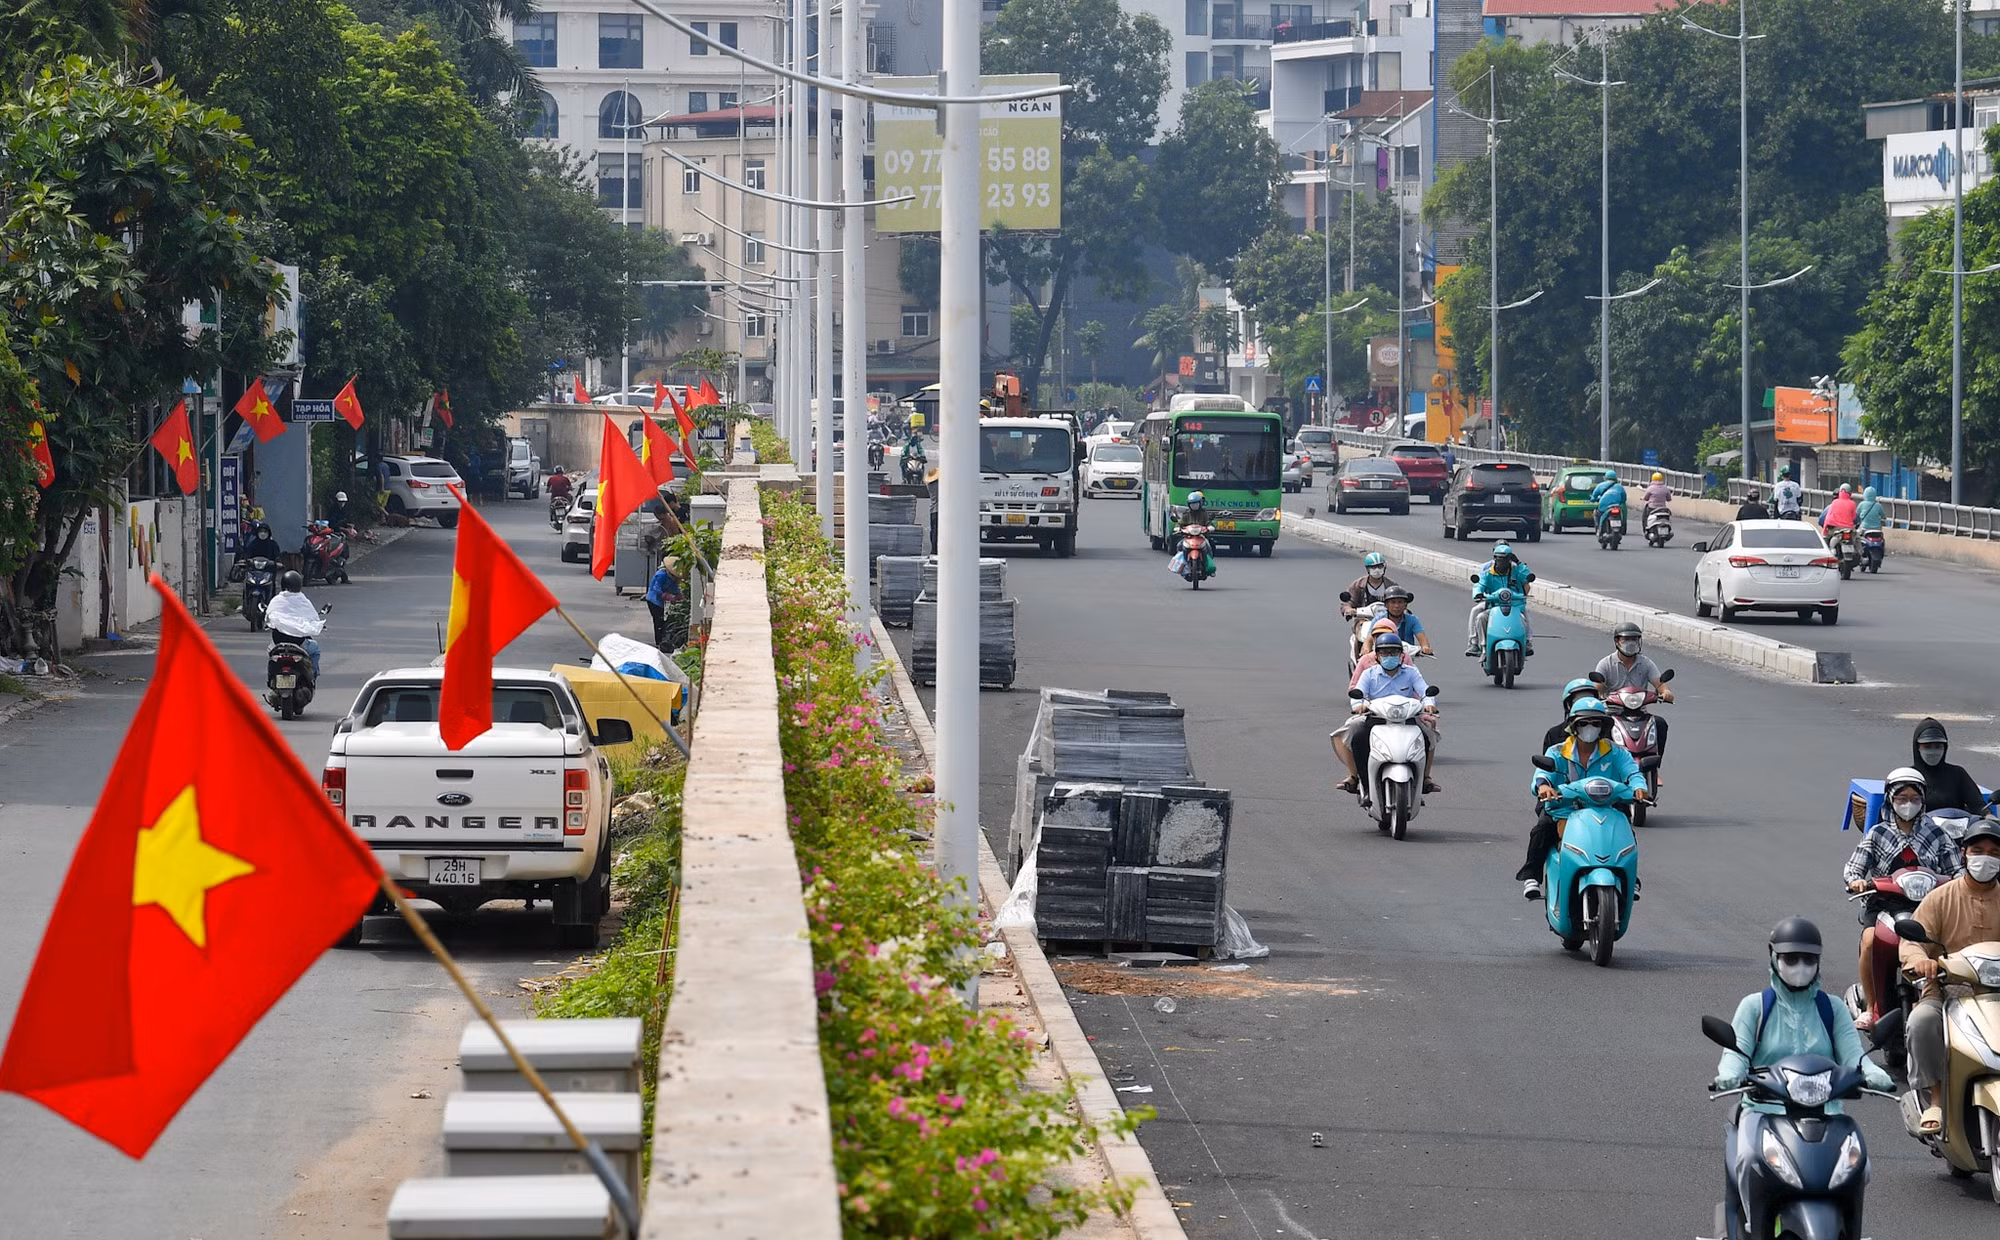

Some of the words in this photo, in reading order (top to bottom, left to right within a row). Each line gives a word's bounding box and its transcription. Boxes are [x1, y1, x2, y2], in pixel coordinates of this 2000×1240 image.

[884, 149, 914, 174] 09
[988, 147, 1015, 172] 55
[1022, 147, 1050, 171] 88
[883, 185, 914, 210] 09
[987, 183, 1015, 208] 23
[1022, 183, 1050, 208] 93
[295, 405, 311, 414] TẠP
[312, 403, 330, 412] HÓA
[352, 815, 559, 829] RANGER
[443, 860, 466, 871] 29H
[435, 873, 475, 883] 440.16
